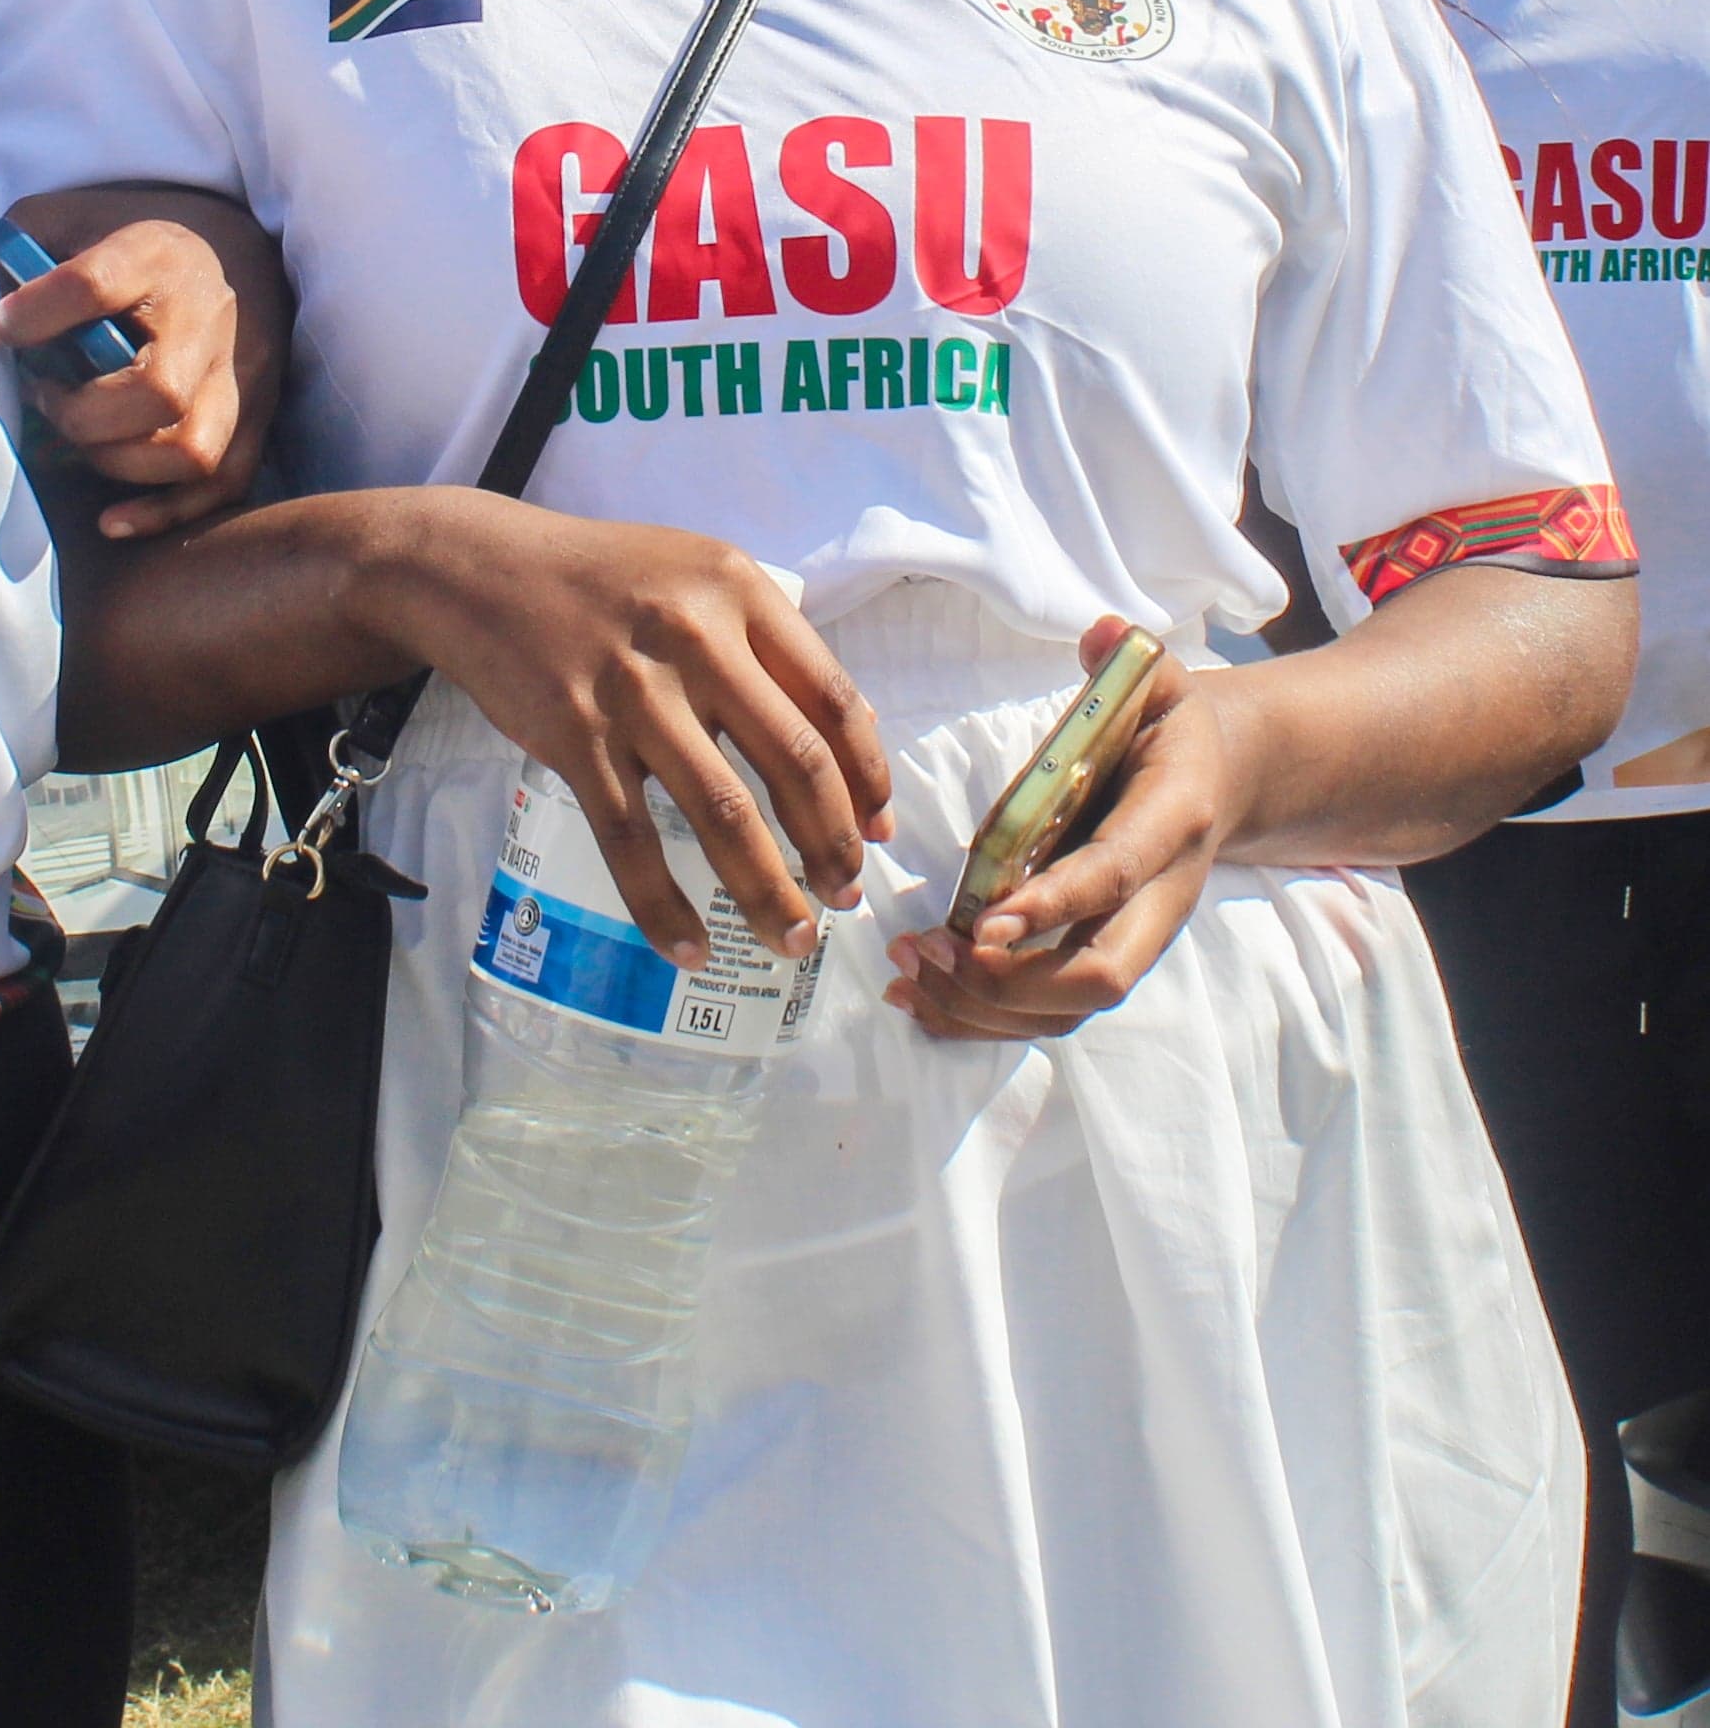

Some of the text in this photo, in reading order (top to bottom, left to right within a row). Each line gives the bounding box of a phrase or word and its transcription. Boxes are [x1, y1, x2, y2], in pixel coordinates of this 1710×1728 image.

[1039, 35, 1137, 59] SOUTH AFRICA
[512, 115, 1032, 325] GASU
[531, 341, 762, 424] OUTH
[781, 337, 1011, 416] AFRICA
[508, 840, 541, 880] WATER
[688, 975, 781, 999] PRODUCT OF SOUTH AFRICA
